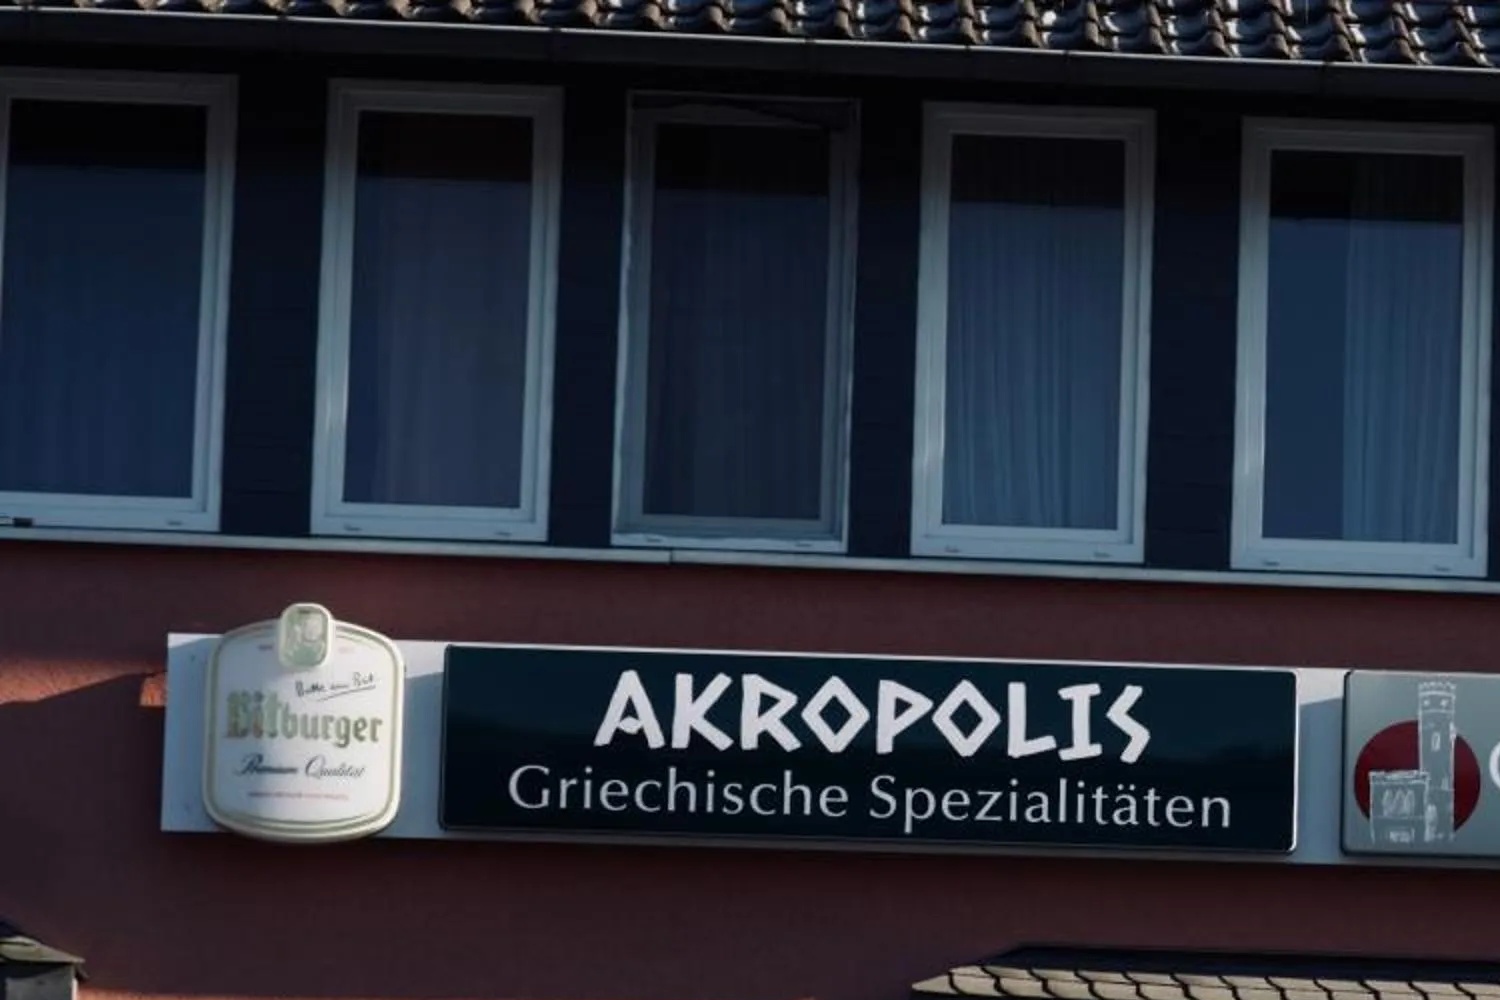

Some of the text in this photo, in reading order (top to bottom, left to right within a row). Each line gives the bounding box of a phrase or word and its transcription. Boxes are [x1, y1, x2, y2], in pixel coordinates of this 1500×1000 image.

[224, 688, 383, 749] Bitburger
[594, 669, 1151, 764] AKROPOLIS
[508, 765, 1230, 835] Griechische Spezialitäten
